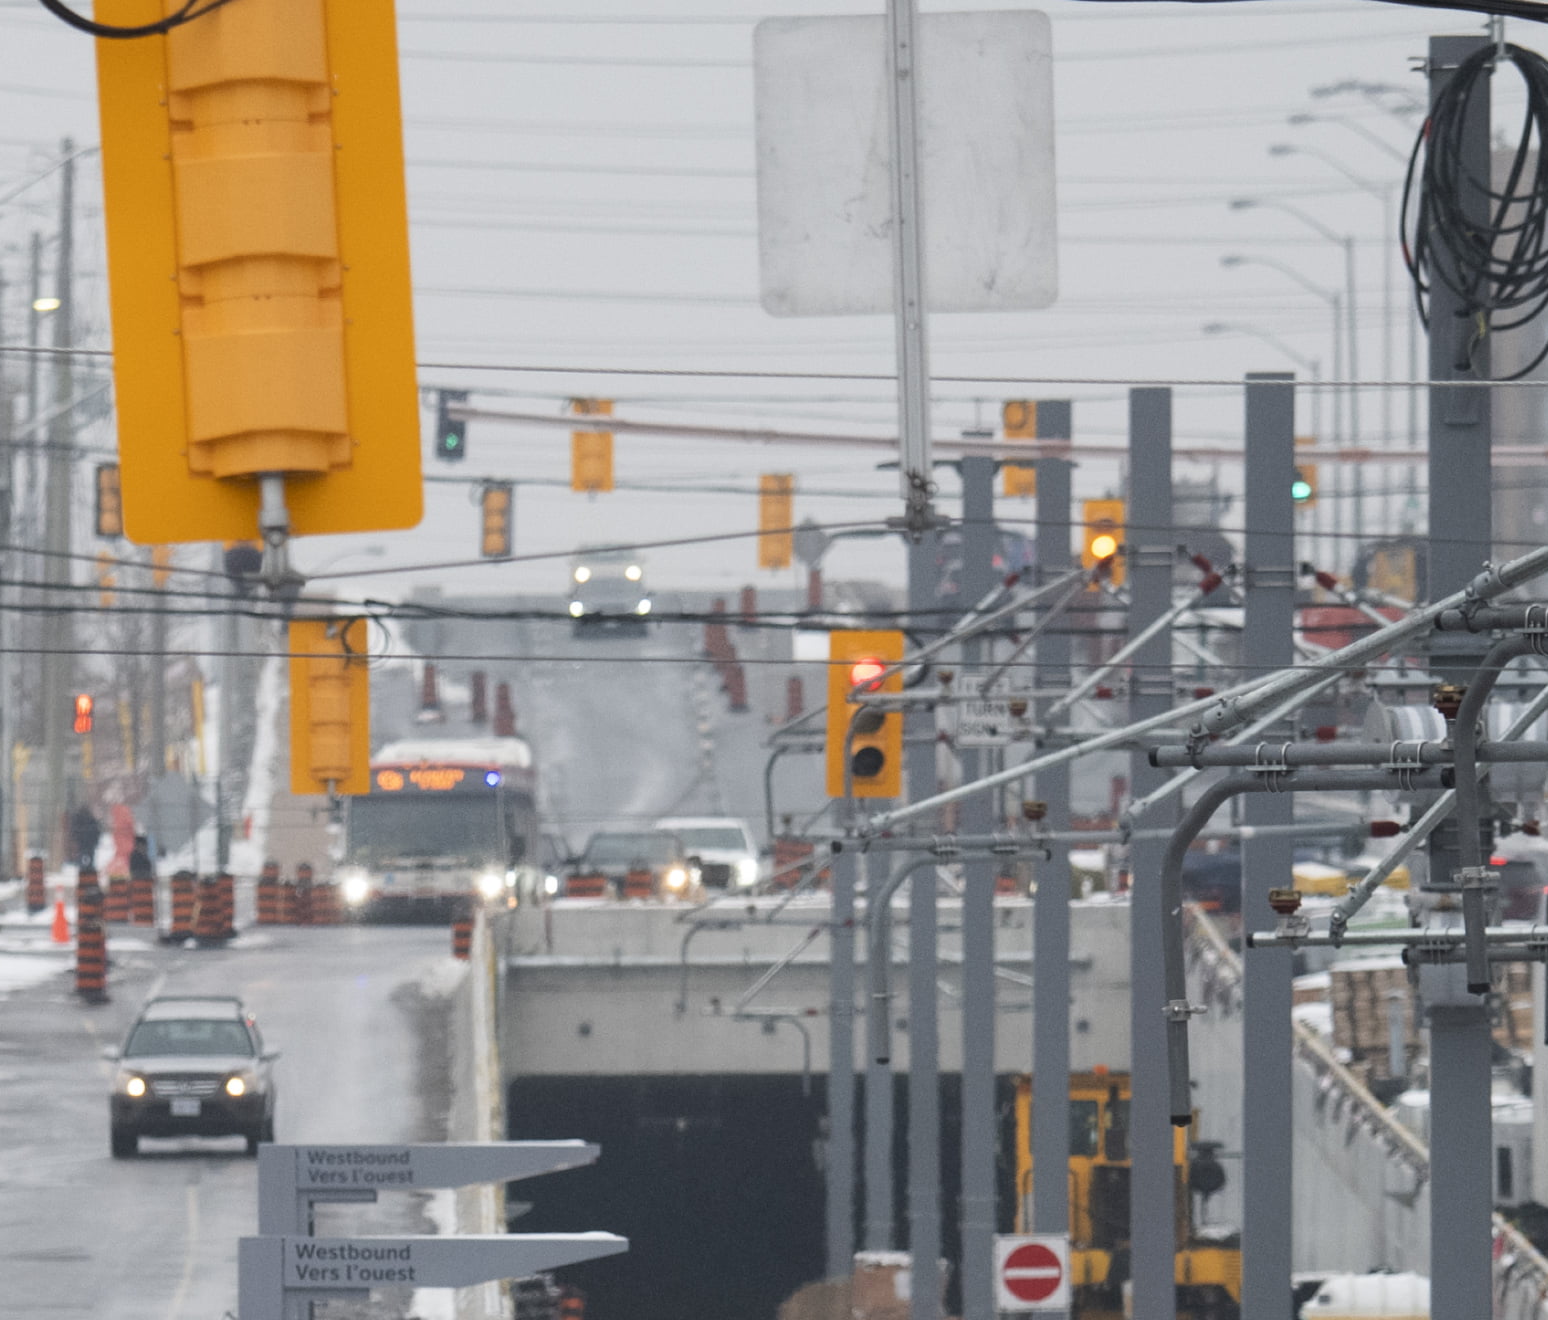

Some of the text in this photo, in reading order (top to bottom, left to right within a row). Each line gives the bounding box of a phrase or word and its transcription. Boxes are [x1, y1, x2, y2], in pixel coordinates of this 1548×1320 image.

[307, 1150, 411, 1166] Westbound
[307, 1170, 348, 1185] Vers
[295, 1243, 412, 1261] Westbound
[295, 1265, 340, 1282] Vers
